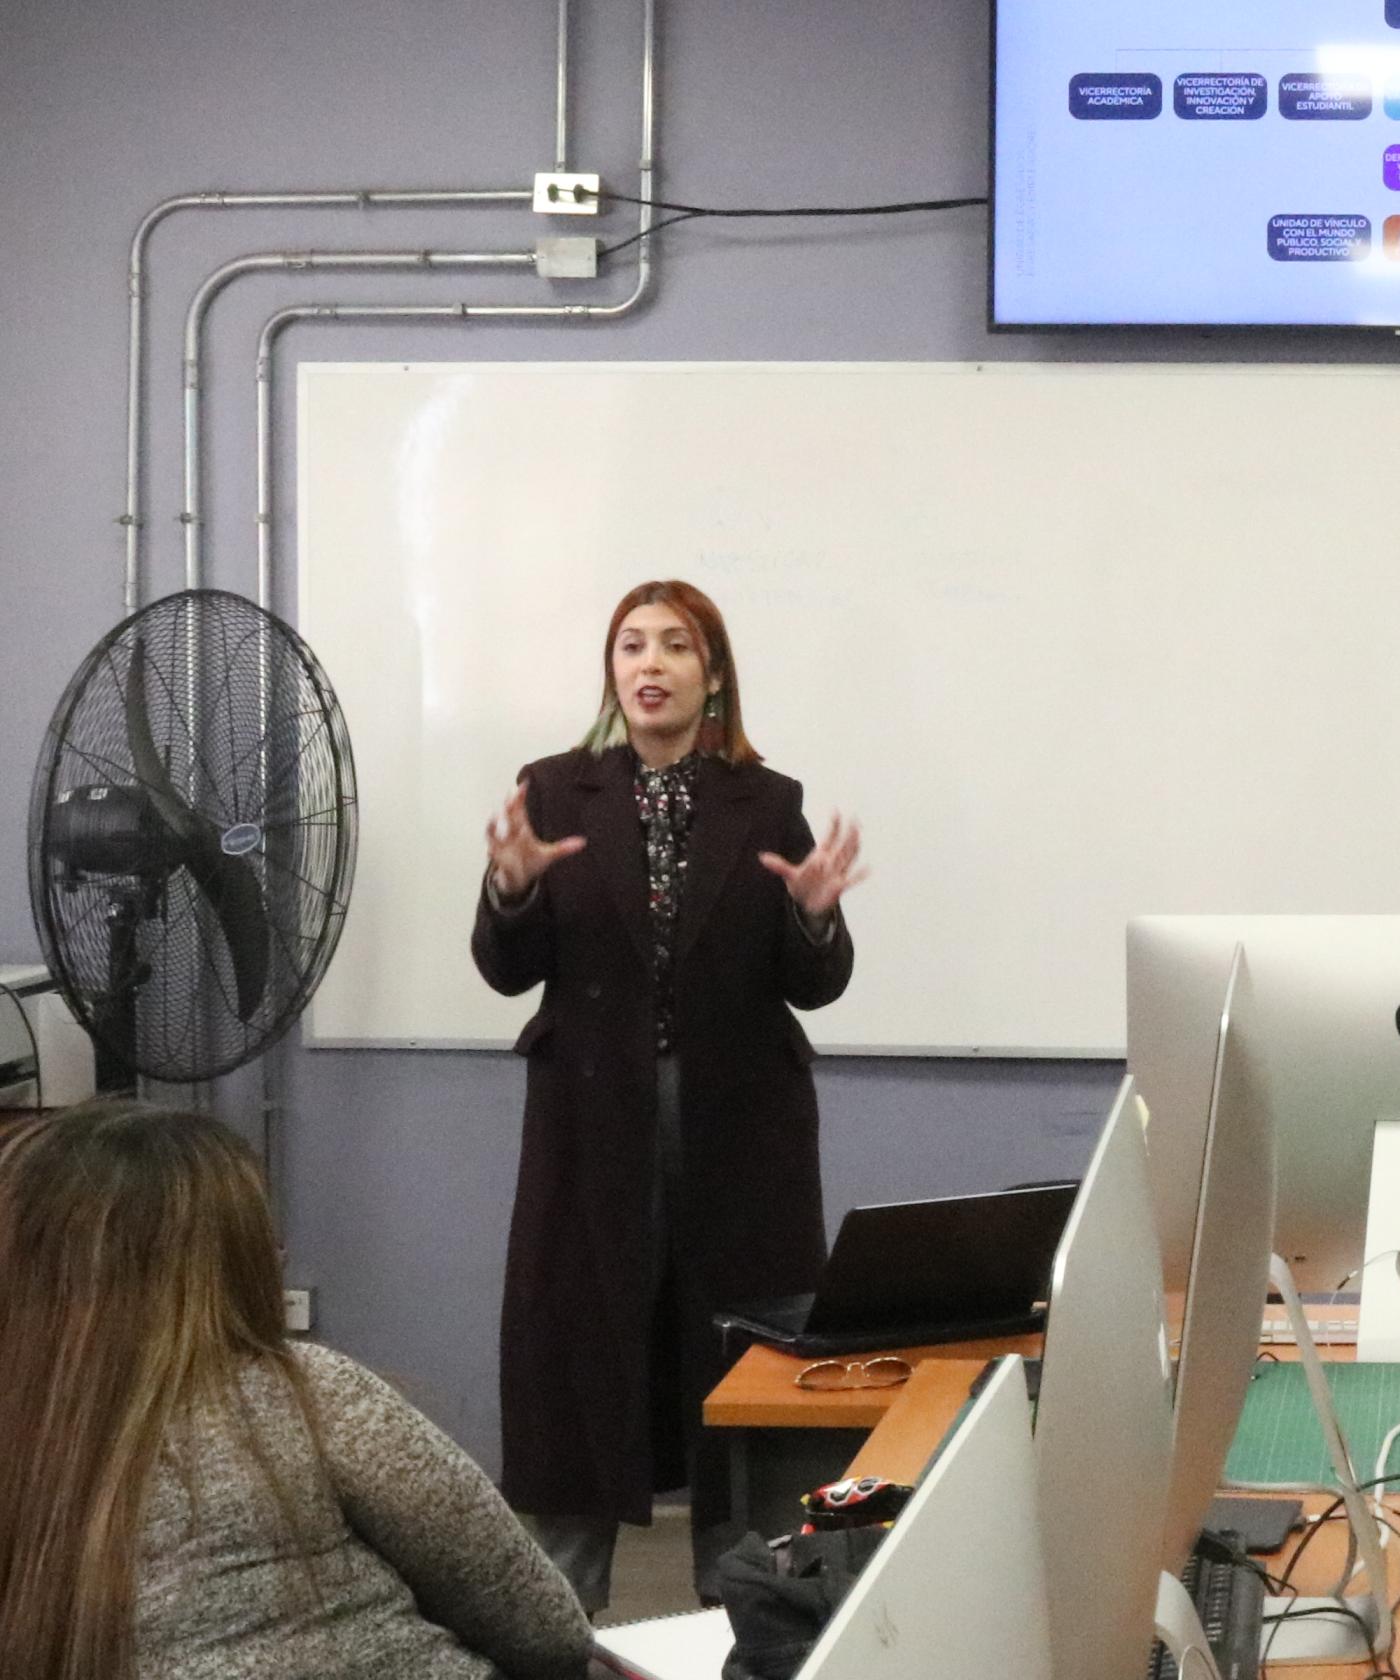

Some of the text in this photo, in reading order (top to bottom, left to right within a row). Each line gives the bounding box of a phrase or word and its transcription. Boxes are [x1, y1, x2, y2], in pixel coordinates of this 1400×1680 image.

[1177, 77, 1264, 86] VICERRECTORÍA DE
[1079, 86, 1151, 96] VICERRECTORÍA
[1087, 96, 1144, 105] ACADÉMICA
[1186, 96, 1245, 105] INNOVACIÓN
[1196, 105, 1245, 114] CREACIÓN
[1296, 102, 1354, 110] ESTUDIANTIL
[1272, 219, 1308, 228] UNIDAD
[1310, 219, 1322, 228] DE
[1283, 229, 1355, 237] CON EL MUNDO
[1320, 238, 1353, 247] SOCIAL
[1288, 247, 1350, 256] PRODUCTIVO
